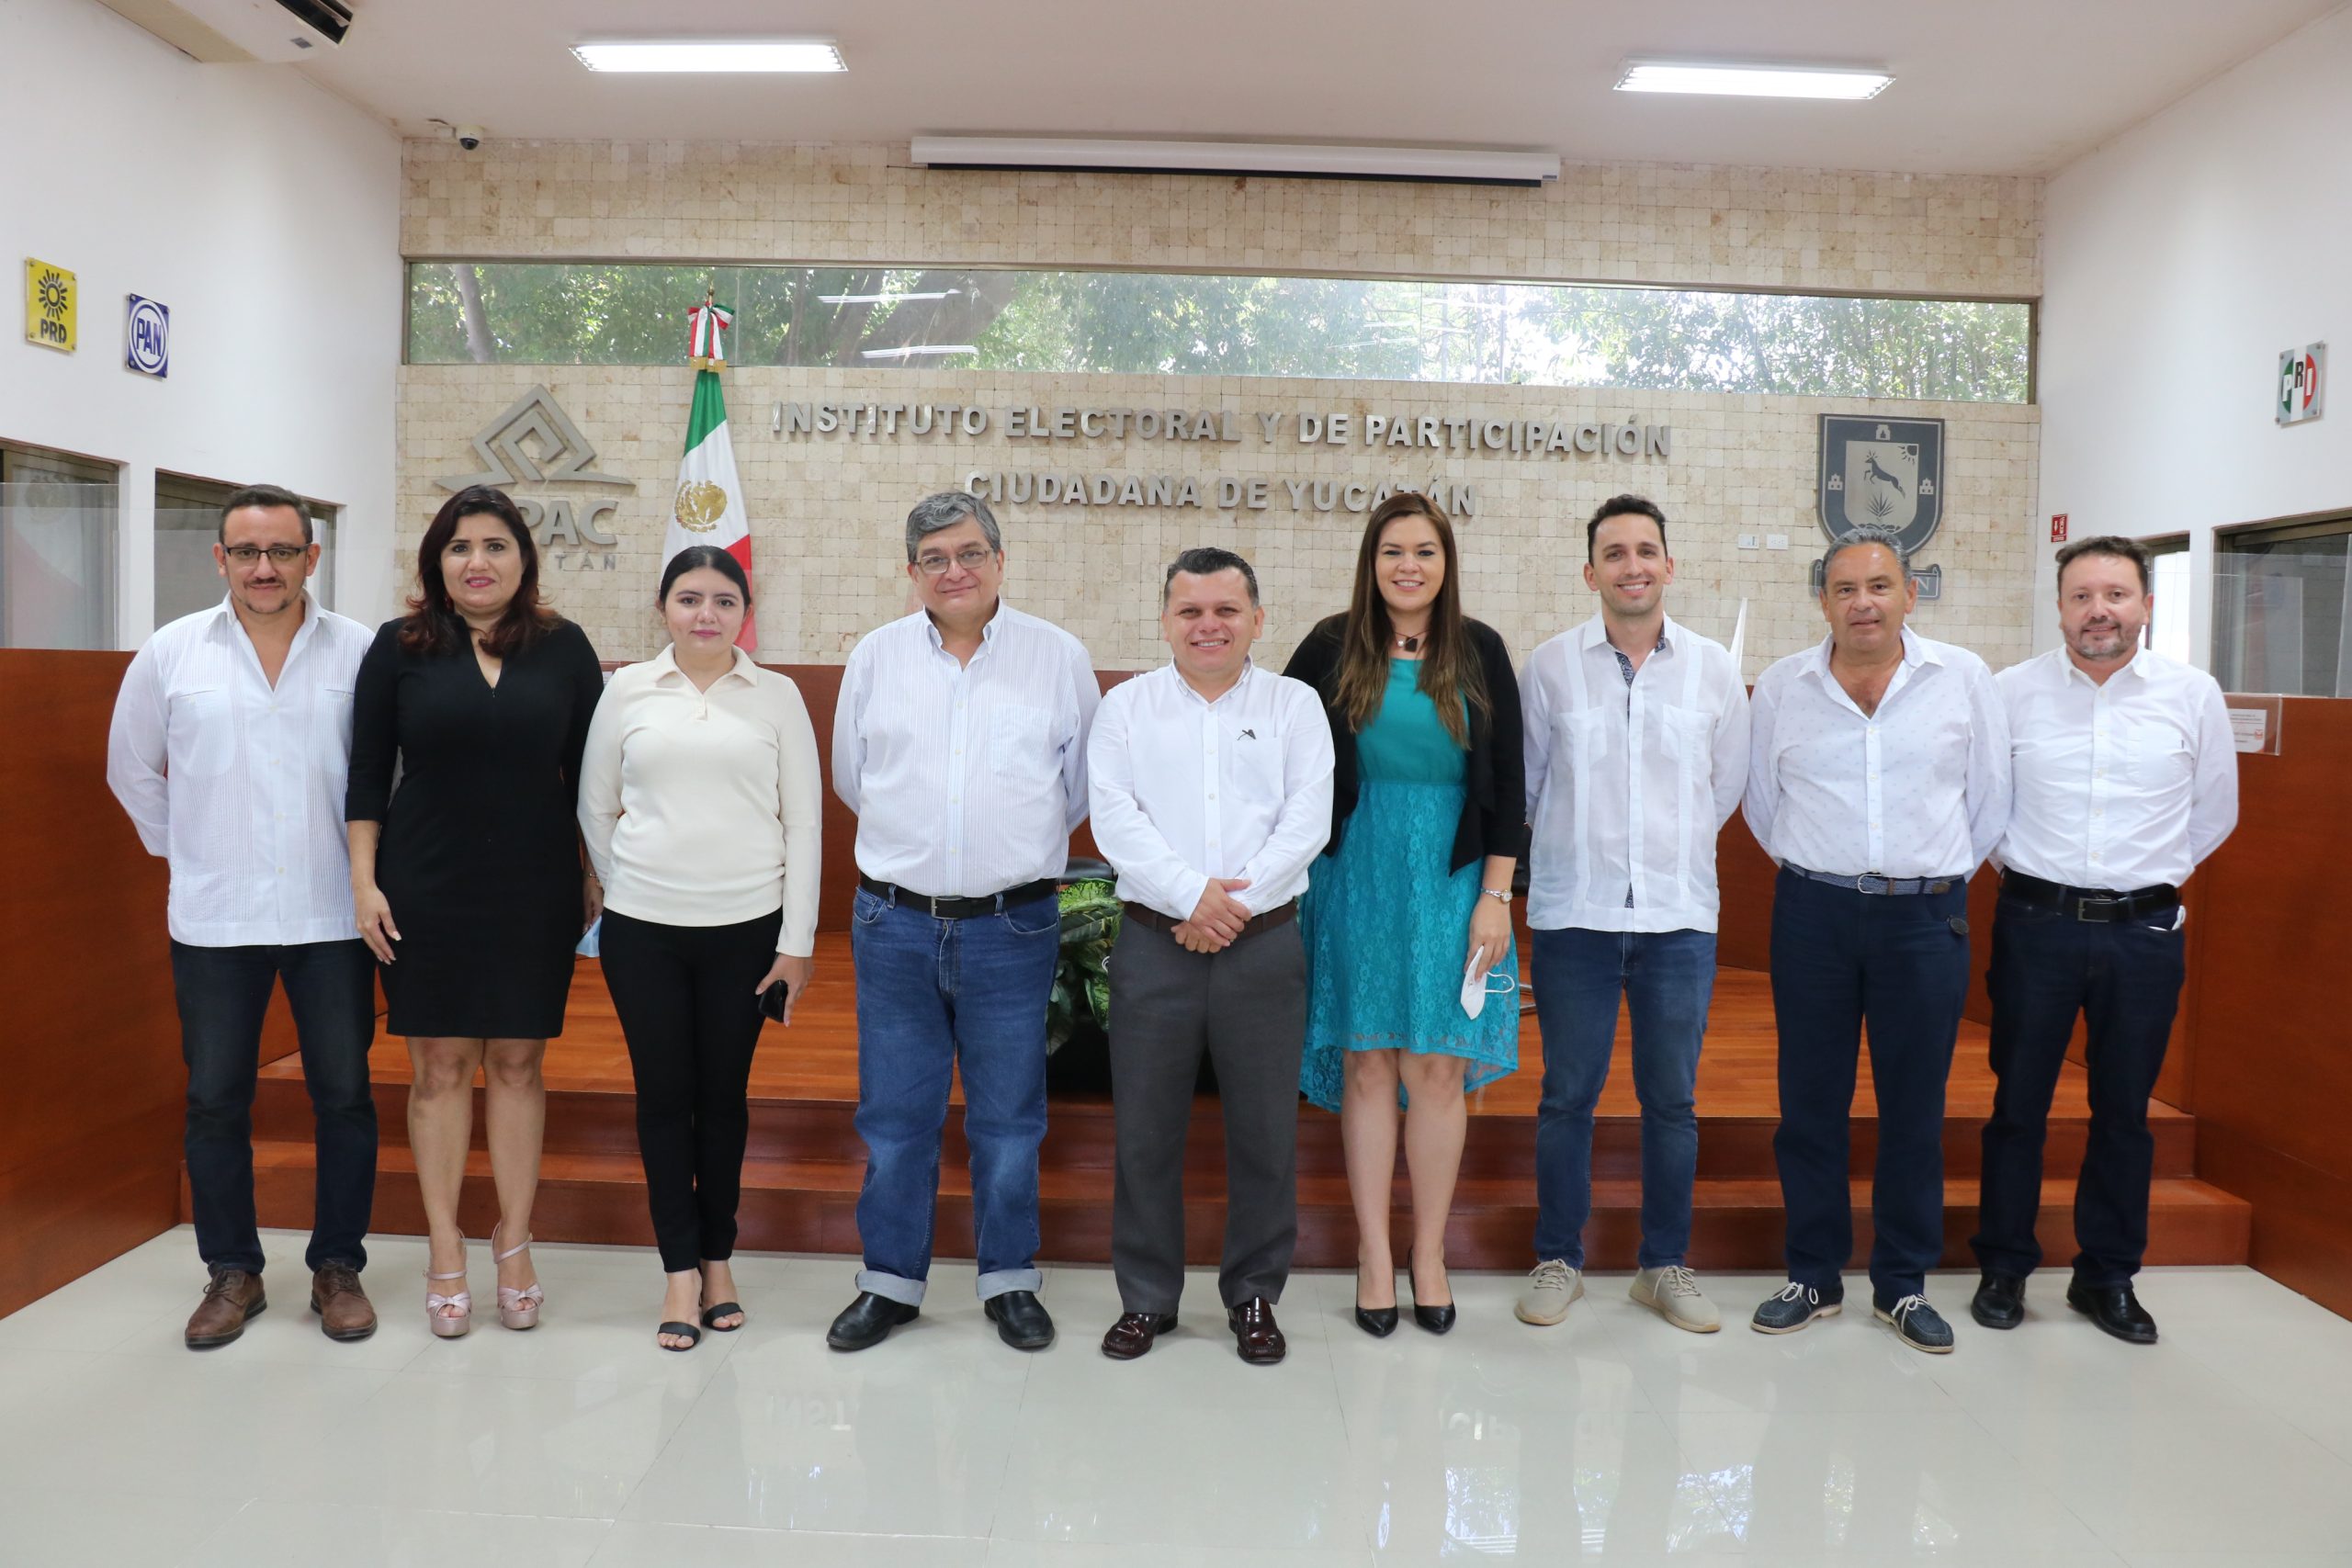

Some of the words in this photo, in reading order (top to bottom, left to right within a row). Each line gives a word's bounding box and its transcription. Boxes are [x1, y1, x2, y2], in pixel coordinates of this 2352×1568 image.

[40, 319, 67, 344] PRD
[136, 318, 163, 357] PAN
[2281, 361, 2313, 402] PRI
[772, 400, 989, 435] INSTITUTO
[1005, 406, 1242, 442] ELECTORAL
[1256, 412, 1284, 444] Y
[1298, 412, 1351, 446] DE
[1365, 413, 1672, 457] PARTICIPACIÓN
[964, 469, 1202, 508] CIUDADANA
[1218, 478, 1269, 510] DE
[512, 499, 619, 546] PAC
